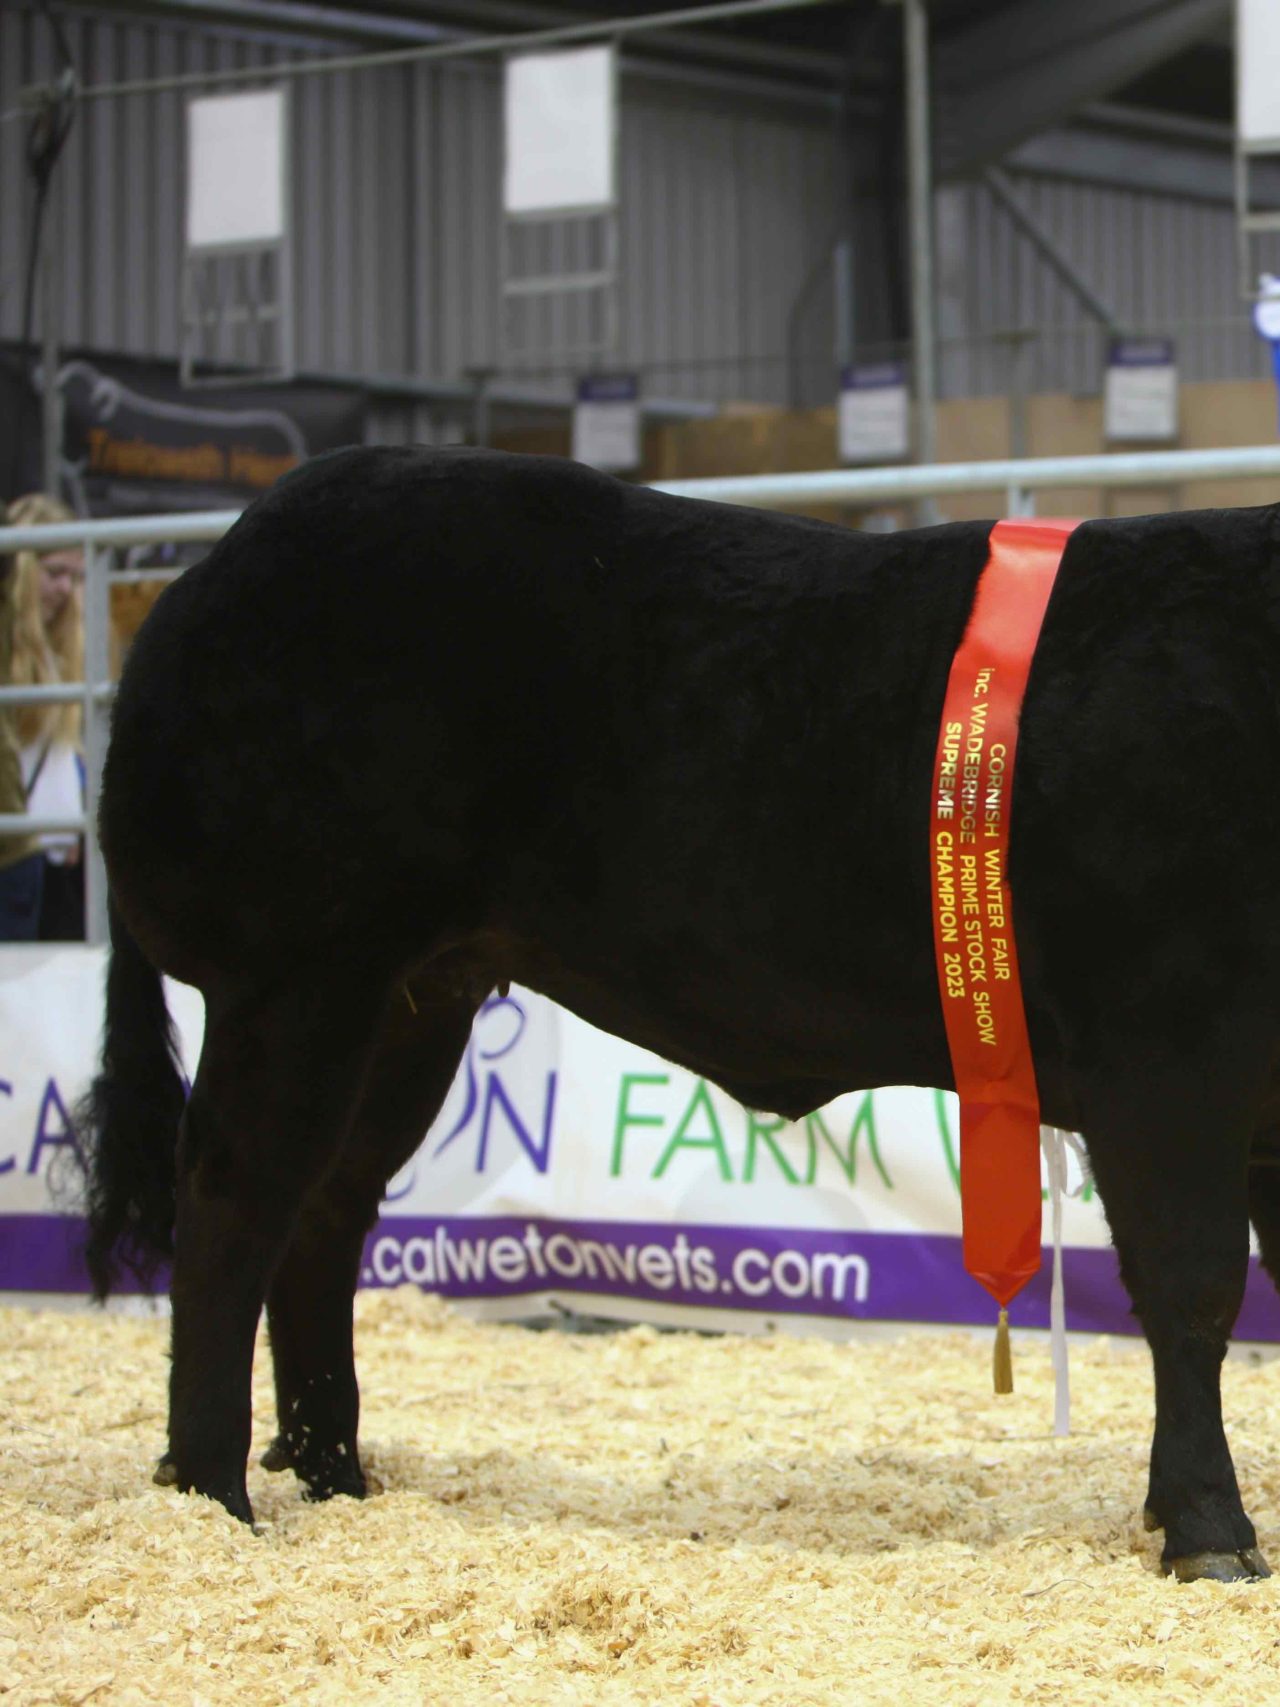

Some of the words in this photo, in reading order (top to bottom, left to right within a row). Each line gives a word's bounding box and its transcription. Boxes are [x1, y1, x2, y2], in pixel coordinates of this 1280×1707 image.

[973, 667, 995, 698] inc.
[937, 721, 963, 820] SUPREME
[960, 702, 989, 844] WADEBRIDGE
[984, 743, 1006, 837] CORNISH
[936, 831, 960, 943] CHAMPION
[959, 855, 980, 915] PRIME
[984, 849, 1005, 928] WINTER
[943, 953, 966, 998] 2023
[964, 920, 987, 983] STOCK
[991, 938, 1011, 980] FAIR
[972, 991, 997, 1046] SHOW
[609, 1072, 895, 1189] FARM
